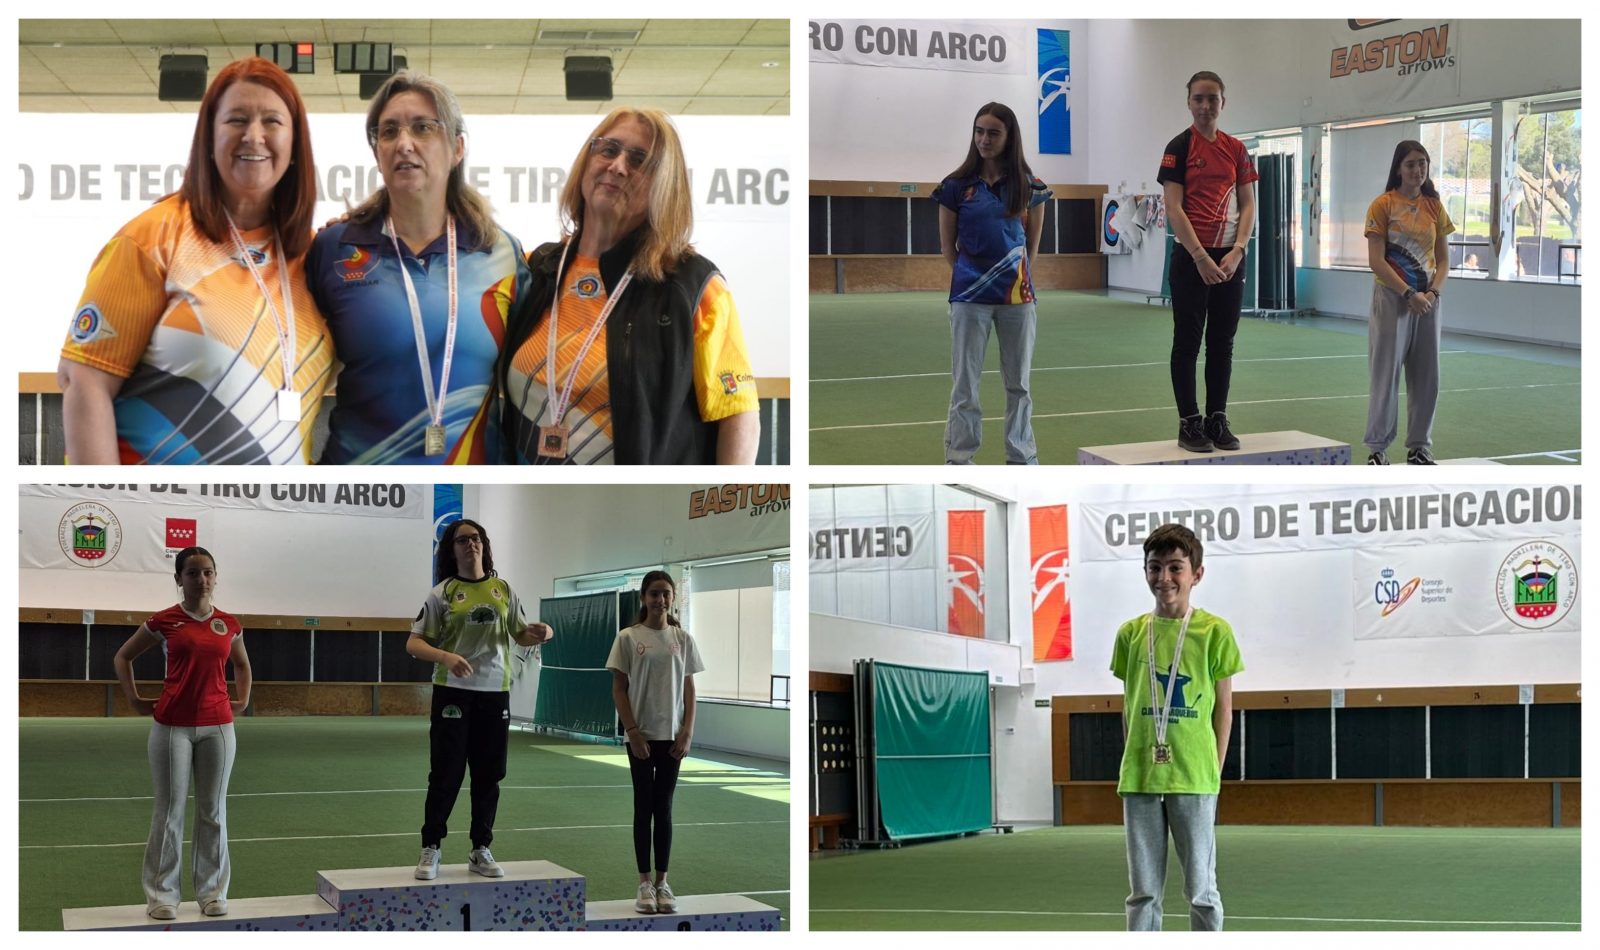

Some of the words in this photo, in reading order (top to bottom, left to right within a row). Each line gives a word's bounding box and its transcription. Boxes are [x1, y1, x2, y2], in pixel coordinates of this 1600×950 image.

[855, 25, 918, 57] CON
[927, 31, 1007, 63] ARCO
[1329, 23, 1449, 78] EASTON
[1398, 55, 1456, 76] arrows
[50, 164, 102, 201] DE
[270, 484, 326, 503] CON
[333, 484, 406, 508] ARCO
[1254, 503, 1299, 539] DE
[1375, 580, 1400, 604] CSD
[460, 903, 471, 932] 1
